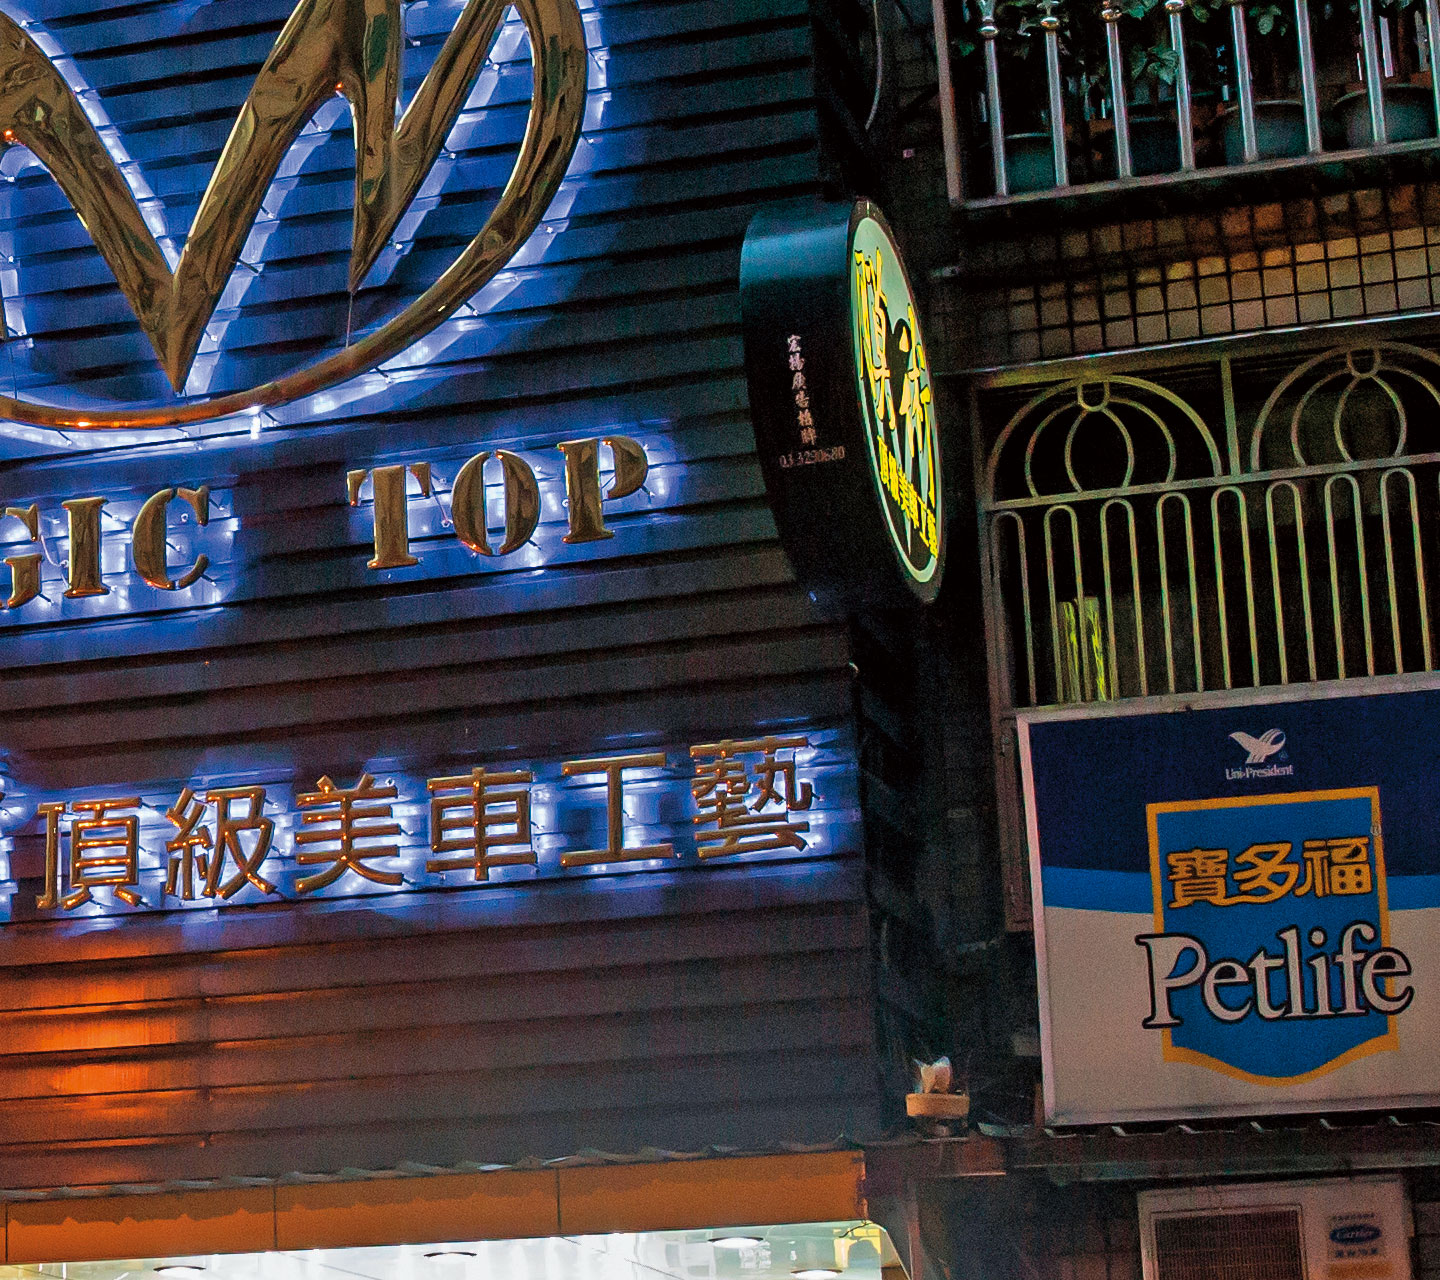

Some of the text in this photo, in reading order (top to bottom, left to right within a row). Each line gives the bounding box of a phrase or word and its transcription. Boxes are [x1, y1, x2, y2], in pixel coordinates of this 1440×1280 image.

[346, 436, 651, 570] TOP
[1166, 835, 1374, 910] 寶多福
[1134, 918, 1417, 1032] Petlife
